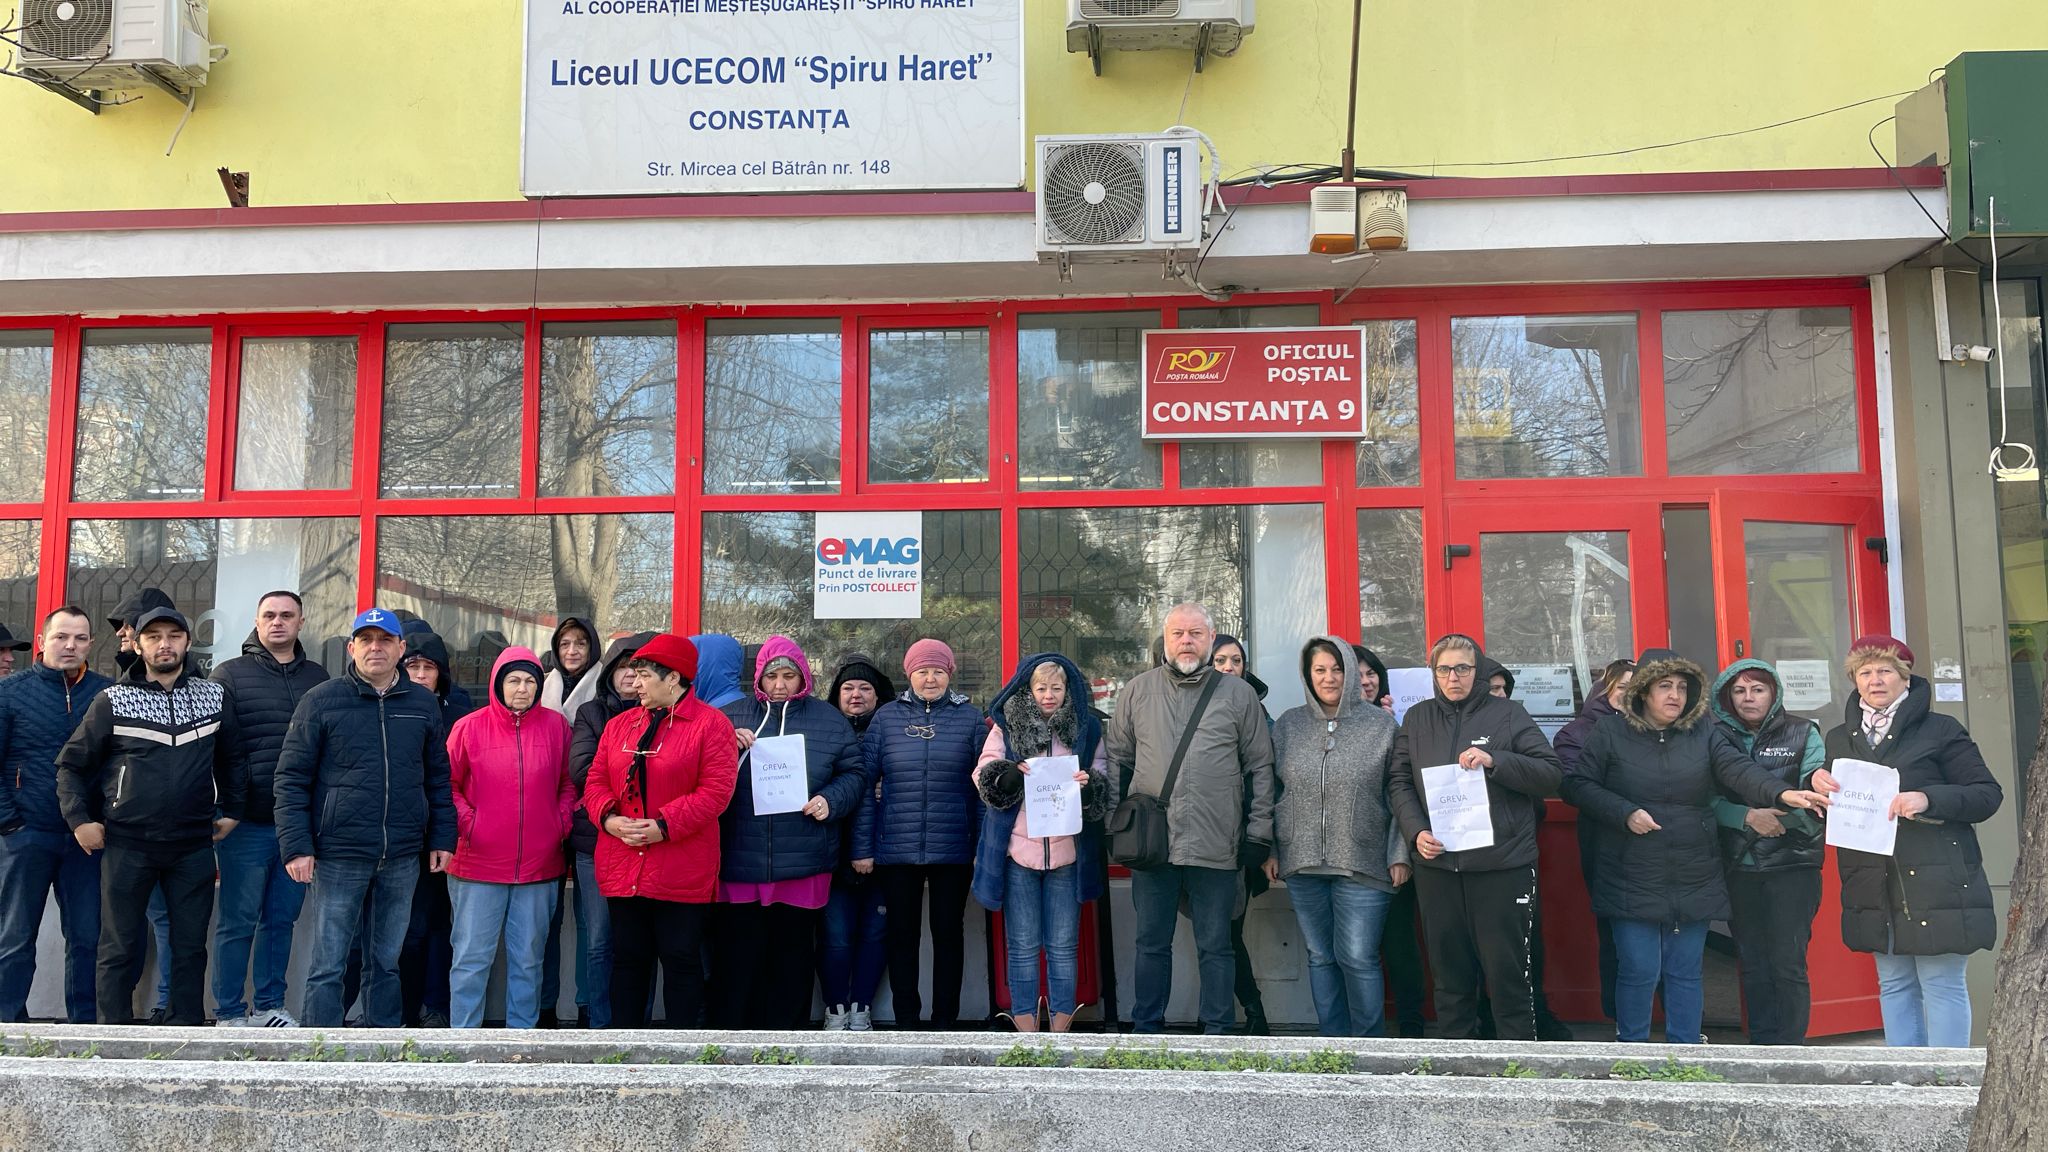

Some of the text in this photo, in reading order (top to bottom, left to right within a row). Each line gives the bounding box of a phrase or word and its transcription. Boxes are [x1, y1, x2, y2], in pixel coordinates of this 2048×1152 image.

[562, 1, 584, 15] AL
[551, 58, 639, 86] Liceul
[650, 56, 785, 86] UCECOM
[689, 108, 851, 135] CONSTANȚA
[647, 159, 891, 177] Str. Mircea cel Bătrân nr. 148
[1167, 151, 1178, 230] HEINNER
[1263, 343, 1354, 361] OFICIUL
[1267, 366, 1351, 386] POȘTAL
[1152, 399, 1355, 426] CONSTANȚA 9
[817, 537, 920, 566] eMAG
[818, 567, 917, 579] Punct de livrare
[818, 583, 917, 593] Prin POSTCOLLECT
[762, 762, 788, 772] GREVA
[1036, 784, 1062, 793] GREVA
[1844, 790, 1874, 802] GREVA
[1439, 794, 1468, 804] GREVA
